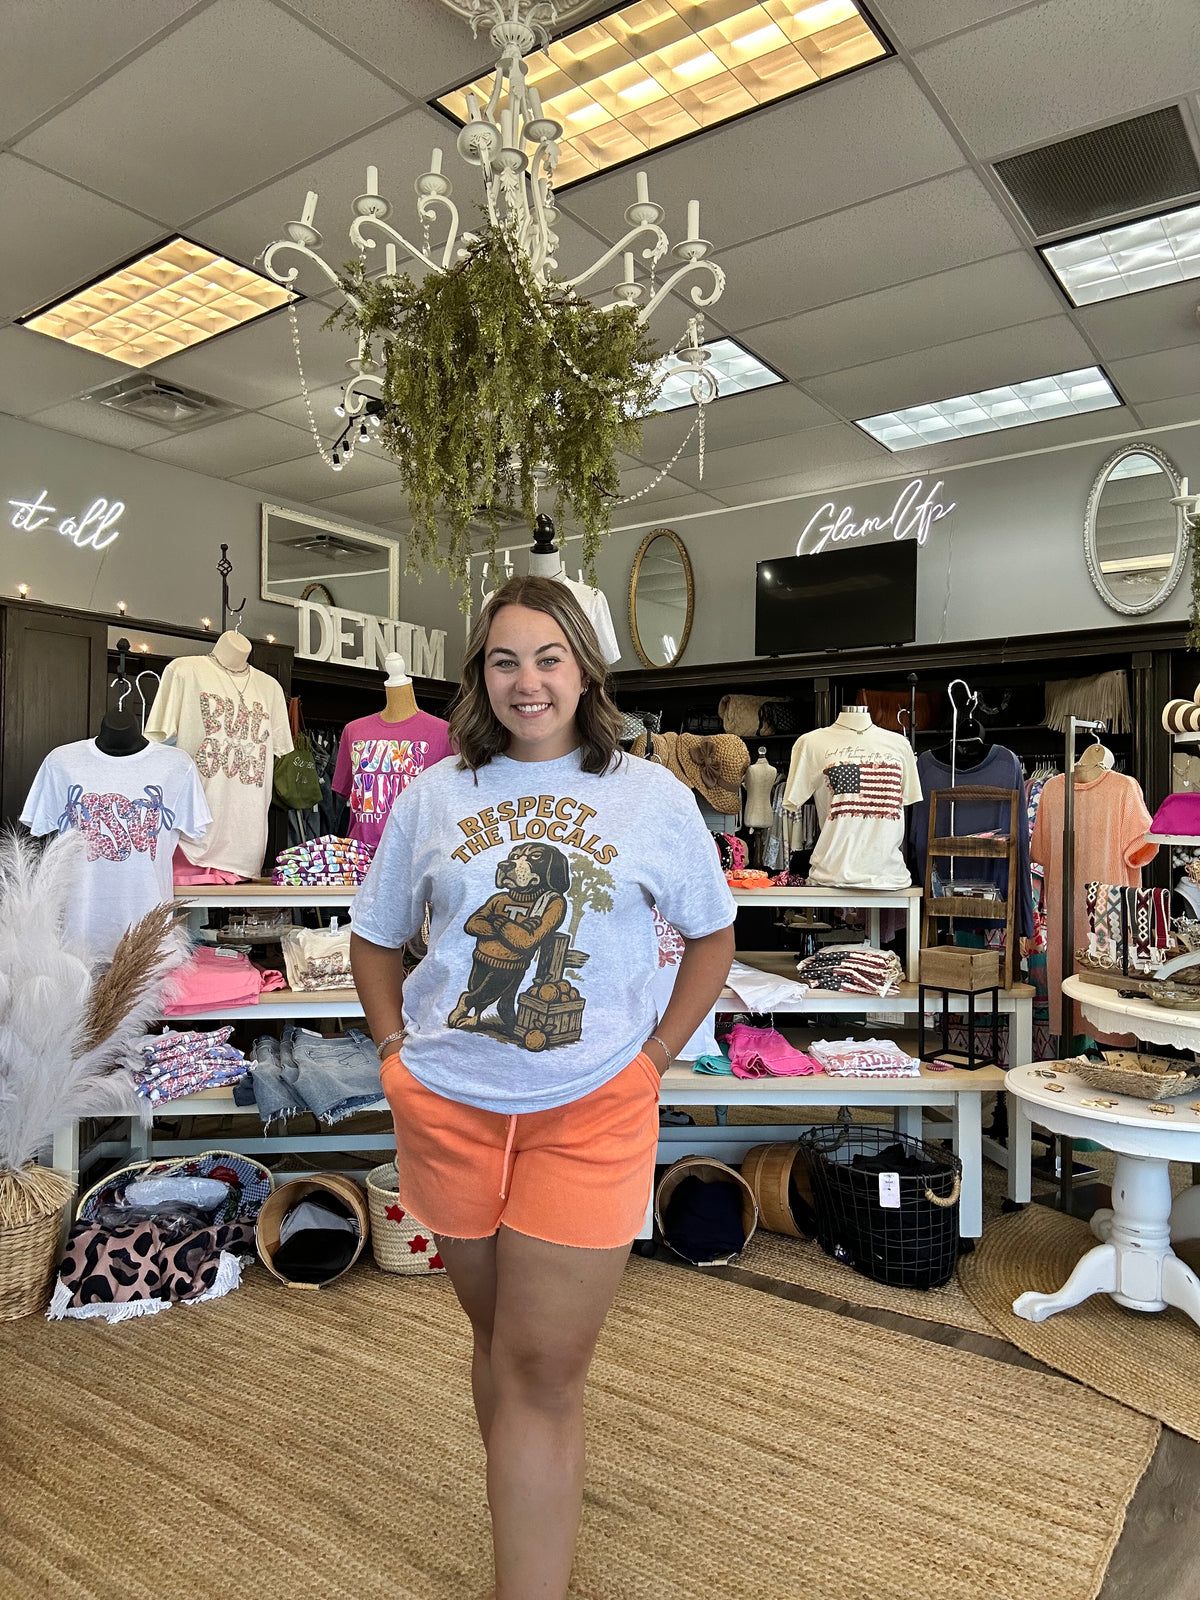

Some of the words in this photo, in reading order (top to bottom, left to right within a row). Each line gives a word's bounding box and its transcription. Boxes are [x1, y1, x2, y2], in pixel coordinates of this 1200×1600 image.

[8, 490, 56, 531] it
[58, 498, 125, 550] all
[796, 502, 892, 556] Glam
[893, 479, 957, 545] Up
[294, 600, 448, 681] DENIM
[451, 826, 504, 864] THE
[508, 818, 618, 865] LOCALS
[457, 795, 597, 838] RESPECT
